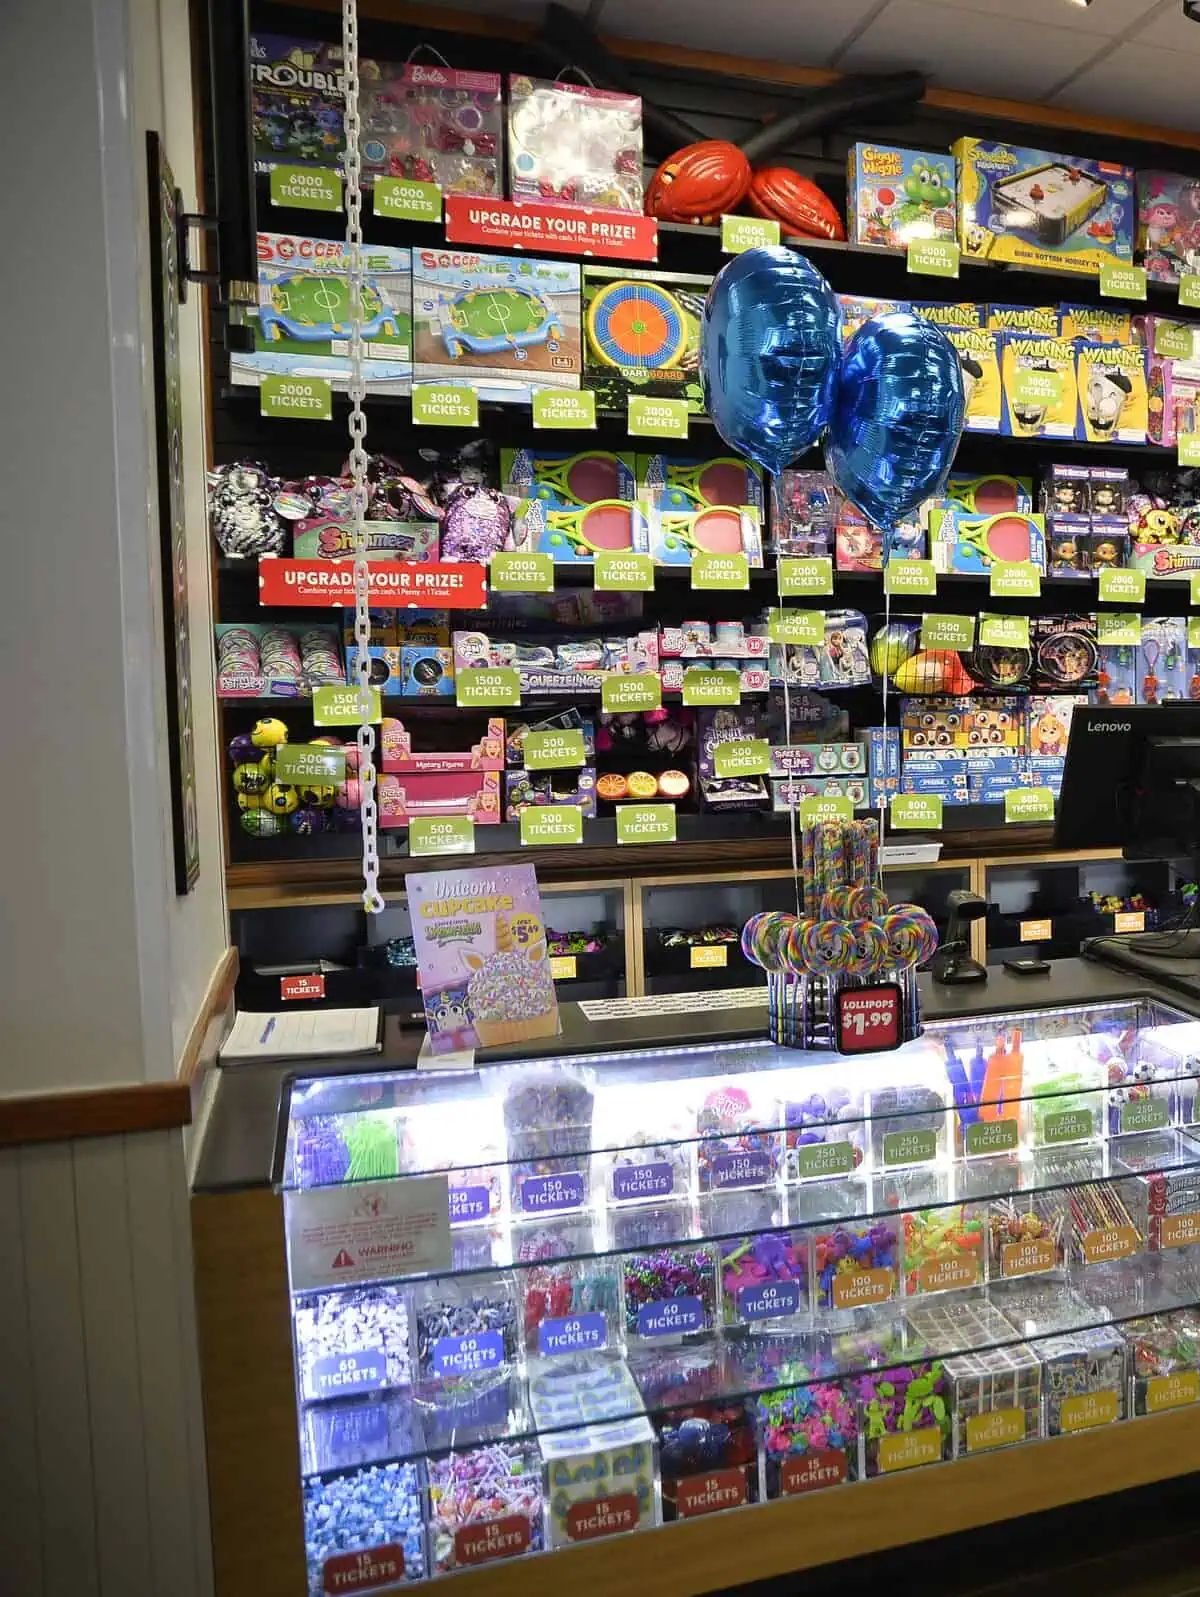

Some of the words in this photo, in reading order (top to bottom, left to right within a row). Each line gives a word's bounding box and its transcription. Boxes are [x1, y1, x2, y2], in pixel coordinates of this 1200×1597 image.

[862, 147, 902, 164] Giggle
[290, 175, 322, 186] 6000
[280, 185, 333, 200] TICKETS
[392, 186, 424, 198] 6000
[383, 196, 433, 211] TICKETS
[469, 210, 541, 230] UPGRADE
[545, 217, 586, 235] YOUR
[592, 222, 636, 240] PRIZE!
[256, 235, 344, 262] SOCCER
[420, 252, 480, 271] SOCCER
[1010, 340, 1075, 360] WALKING
[1083, 347, 1144, 367] WALKING
[622, 368, 647, 378] DART
[280, 384, 312, 396] 3000
[271, 394, 322, 408] TICKETS
[430, 392, 460, 404] 3000
[420, 403, 470, 416] TICKETS
[542, 407, 588, 419] TICKETS
[636, 416, 681, 429] TICKETS
[507, 560, 536, 571] 2000
[609, 560, 638, 571] 2000
[706, 560, 734, 570] 2000
[499, 570, 546, 582] TICKETS
[601, 571, 647, 582] TICKETS
[698, 569, 742, 581] TICKETS
[792, 567, 818, 576] 2000
[897, 567, 922, 577] 2000
[367, 572, 411, 587] YOUR
[415, 573, 463, 588] PRIZE!
[784, 575, 826, 587] TICKETS
[891, 576, 930, 587] TICKETS
[937, 622, 959, 632] 1500
[927, 631, 968, 643] TICKETS
[750, 641, 760, 649] 10
[476, 676, 501, 686] 1500
[619, 682, 644, 692] 1500
[700, 677, 723, 686] 1500
[464, 685, 513, 697] TICKETS
[690, 686, 733, 696] TICKETS
[608, 692, 655, 703] TICKETS
[1088, 721, 1132, 732] Lenovo
[543, 737, 564, 747] 500
[531, 746, 578, 759] TICKETS
[732, 748, 752, 757] 500
[299, 754, 322, 764] 500
[416, 760, 440, 770] Mystery
[441, 760, 464, 770] Figures
[721, 756, 764, 768] TICKETS
[283, 763, 338, 776] TICKETS
[908, 801, 927, 810] 800
[541, 814, 562, 824] 500
[636, 813, 657, 822] 500
[898, 810, 937, 820] TICKETS
[431, 824, 453, 834] 500
[529, 823, 575, 835] TICKETS
[624, 822, 669, 834] TICKETS
[434, 879, 497, 897] Unicorn
[299, 979, 309, 987] 15
[286, 985, 322, 994] TICKETS
[843, 999, 894, 1010] LOLLIPOPS
[844, 1012, 893, 1036] $1.99
[1127, 1111, 1164, 1125] TICKETS
[1049, 1122, 1088, 1137] TICKETS
[900, 1136, 918, 1147] 250
[973, 1134, 1014, 1146] TICKETS
[889, 1145, 931, 1158] TICKETS
[731, 1157, 751, 1169] 150
[804, 1156, 849, 1170] TICKETS
[632, 1168, 653, 1180] 150
[718, 1167, 765, 1181] TICKETS
[543, 1181, 563, 1192] 150
[619, 1178, 668, 1193] TICKETS
[528, 1190, 577, 1205] TICKETS
[1177, 1219, 1195, 1230] 100
[1102, 1231, 1120, 1242] 100
[1020, 1246, 1038, 1257] 100
[1091, 1240, 1130, 1255] TICKETS
[939, 1261, 958, 1274] 100
[1010, 1253, 1051, 1270] TICKETS
[851, 1275, 871, 1287] 100
[928, 1267, 970, 1284] TICKETS
[763, 1287, 777, 1299] 60
[839, 1284, 885, 1299] TICKETS
[746, 1296, 794, 1311] TICKETS
[664, 1304, 679, 1316] 60
[565, 1321, 581, 1333] 60
[646, 1313, 697, 1329] TICKETS
[546, 1330, 599, 1347] TICKETS
[460, 1339, 476, 1351] 60
[441, 1349, 497, 1366] TICKETS
[339, 1358, 357, 1371] 60
[319, 1368, 377, 1386] TICKETS
[807, 1458, 820, 1470] 15
[789, 1467, 840, 1485] TICKETS
[706, 1479, 719, 1490] 15
[685, 1487, 739, 1509] TICKETS
[596, 1502, 610, 1514] 15
[576, 1510, 632, 1531] TICKETS
[464, 1532, 523, 1556] TICKETS
[333, 1561, 396, 1586] TICKETS
